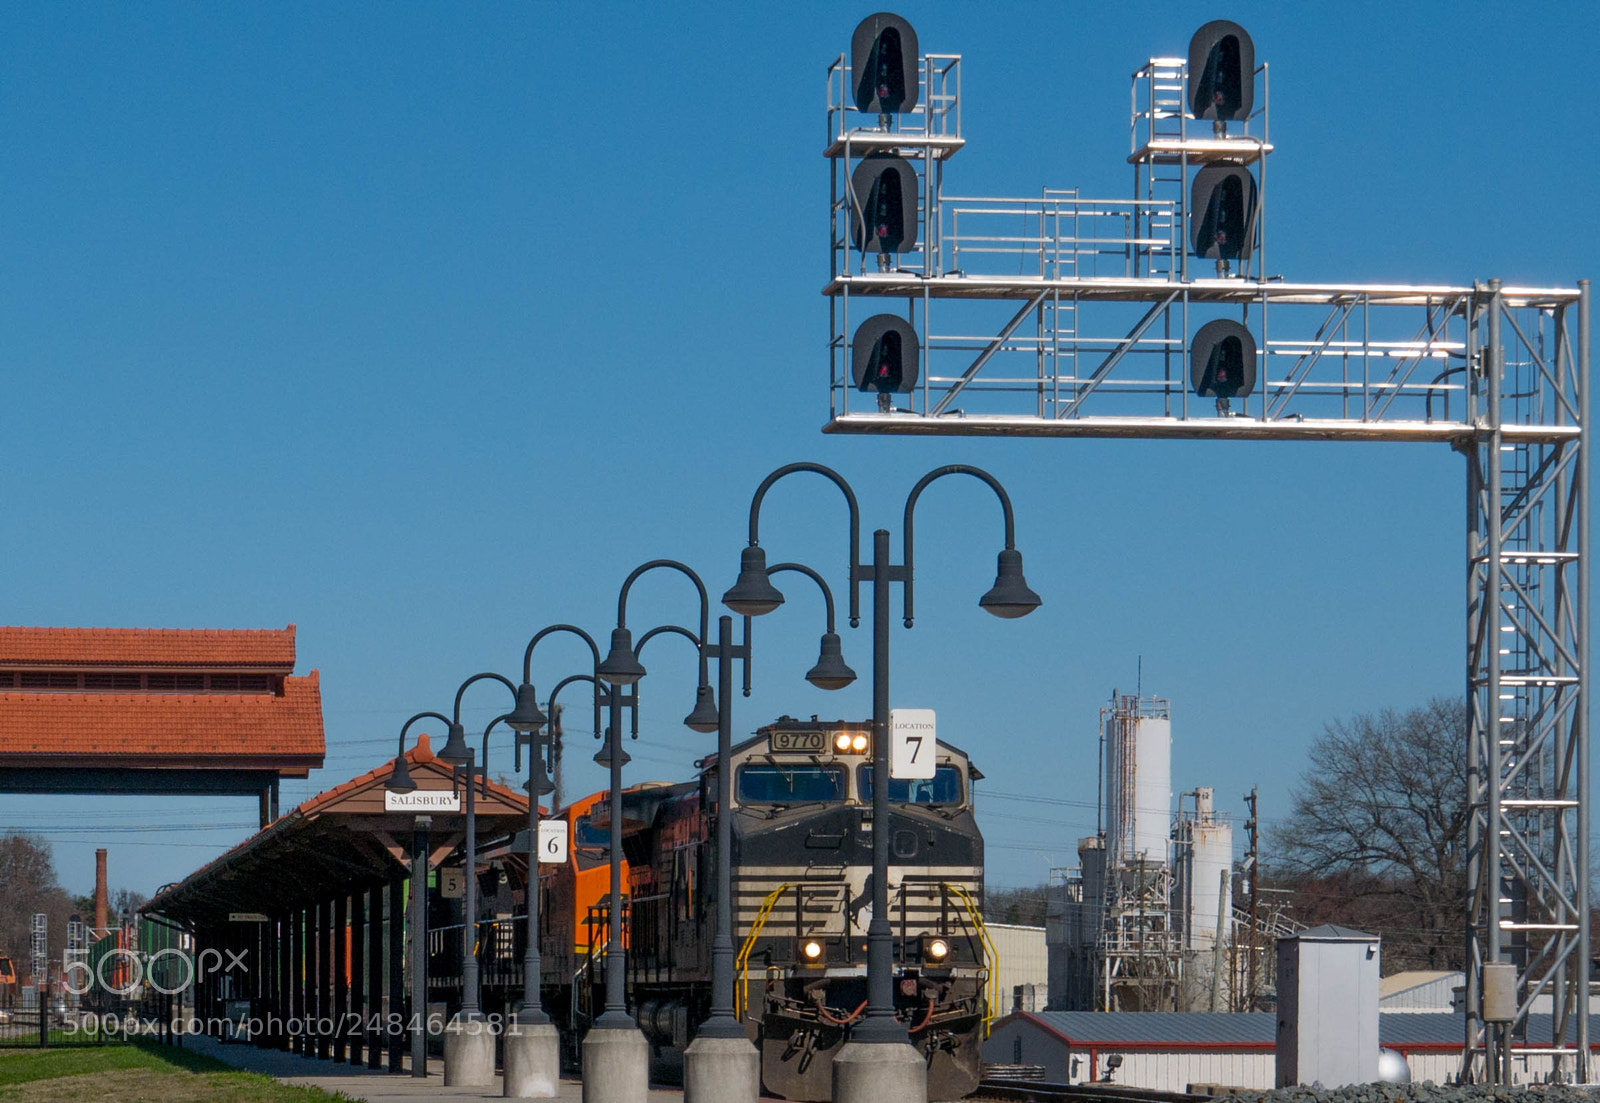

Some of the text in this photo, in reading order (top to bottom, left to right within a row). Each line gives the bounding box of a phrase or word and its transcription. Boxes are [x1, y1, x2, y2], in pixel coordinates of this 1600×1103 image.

[780, 734, 820, 748] 9770
[905, 736, 923, 764] 7
[391, 796, 454, 805] SALISBURY
[547, 836, 558, 854] 6
[448, 878, 457, 892] 5
